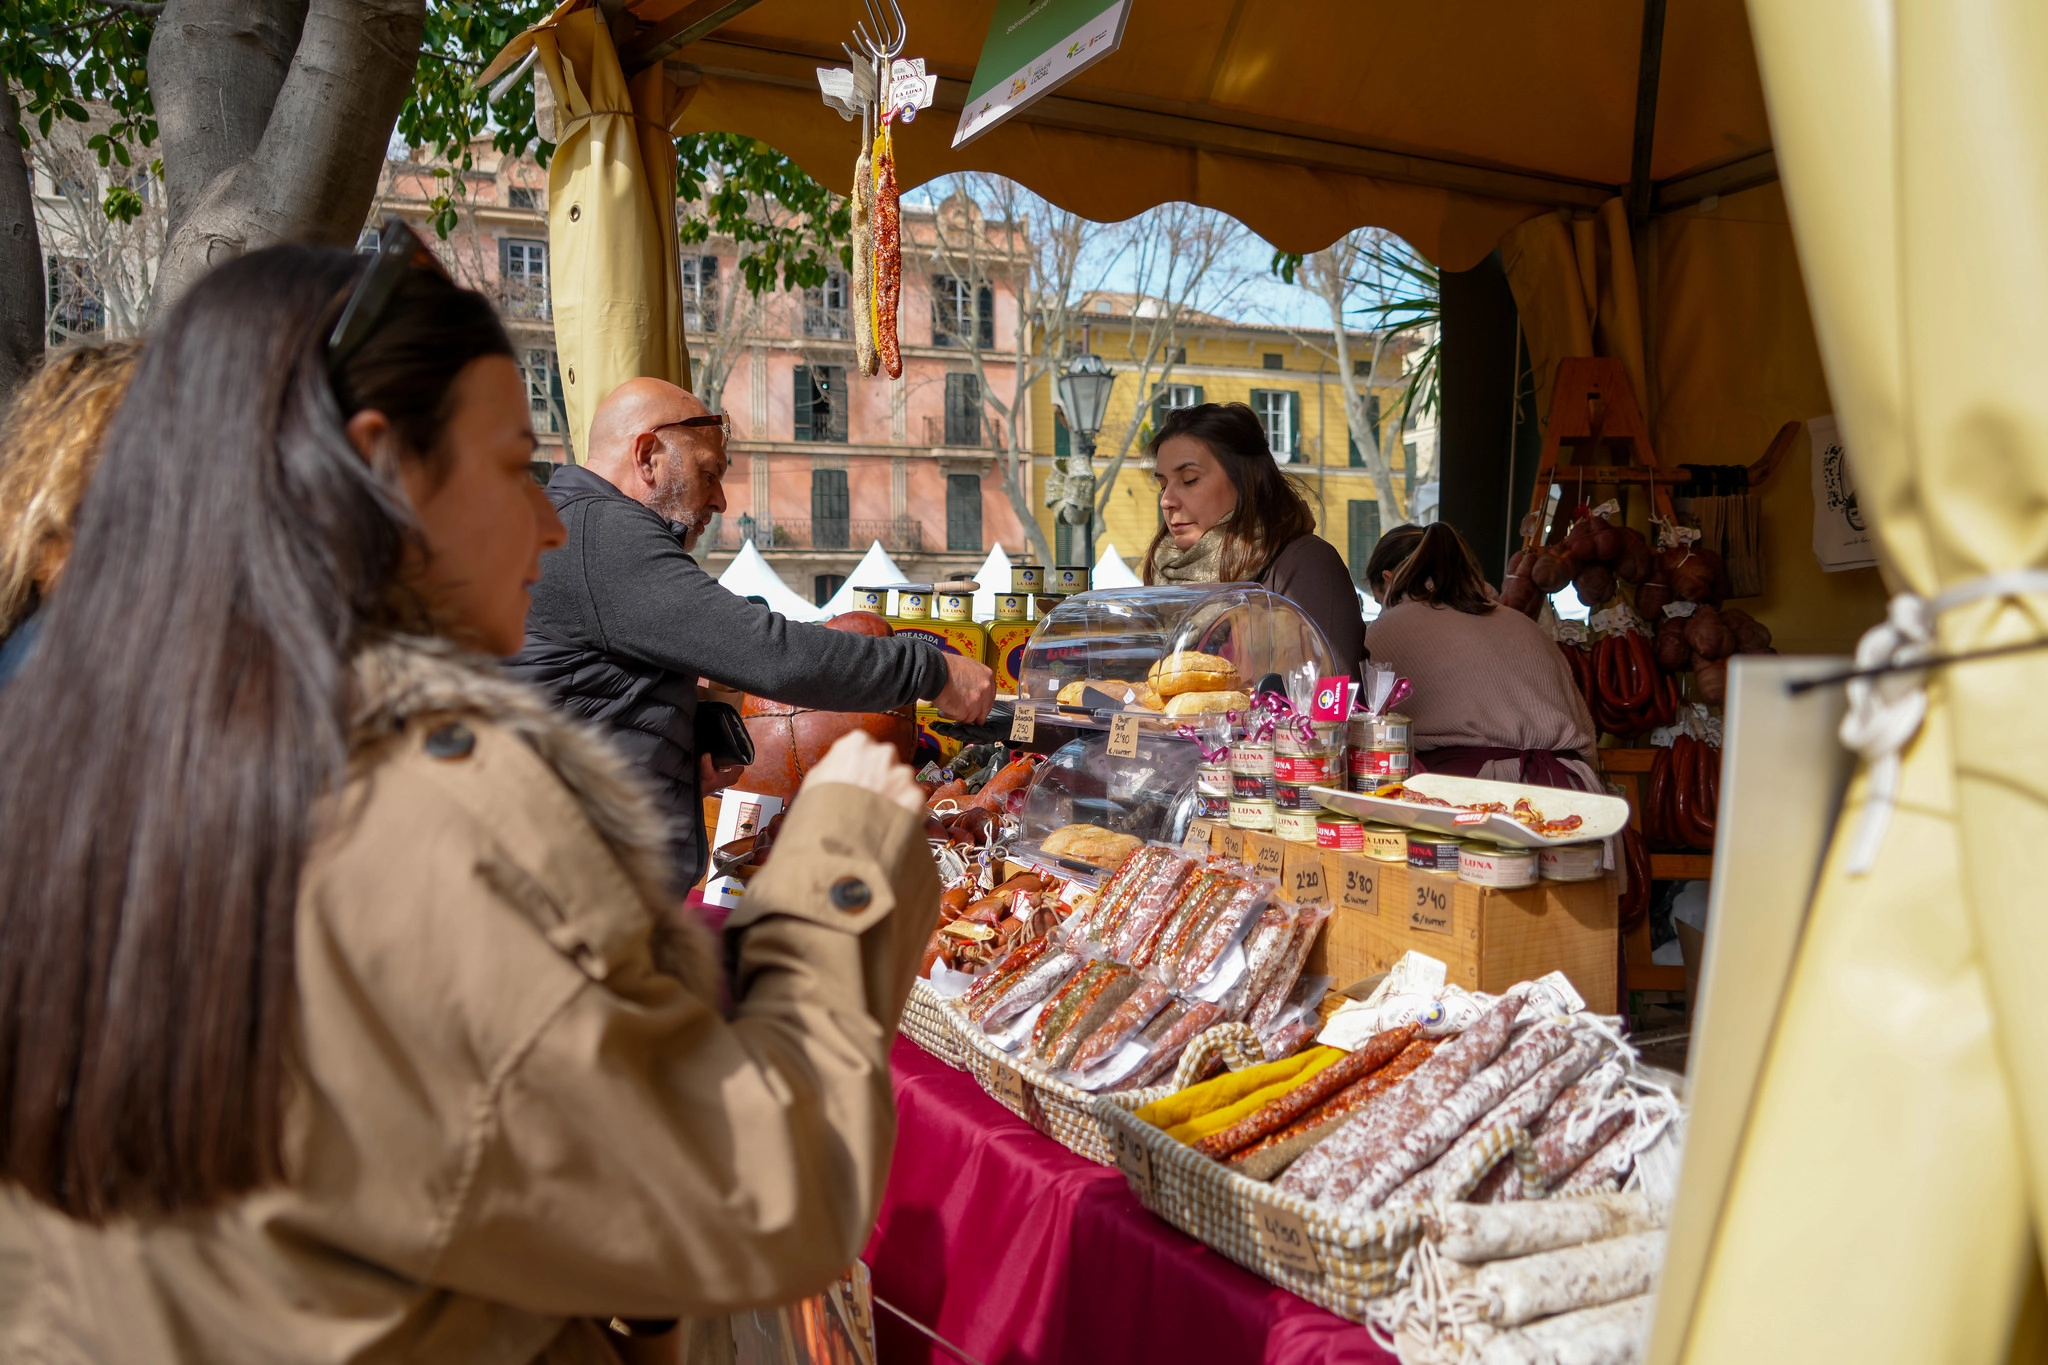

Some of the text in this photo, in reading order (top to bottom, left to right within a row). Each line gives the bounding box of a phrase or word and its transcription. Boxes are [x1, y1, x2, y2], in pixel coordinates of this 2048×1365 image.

[905, 87, 923, 96] LUNA
[1334, 681, 1342, 703] LUNA
[1333, 703, 1340, 715] LA
[1238, 780, 1262, 788] LUNA
[1207, 800, 1219, 808] LA
[1237, 807, 1262, 815] LUNA
[1373, 837, 1399, 845] LUNA
[1258, 846, 1280, 863] 12'50
[1464, 856, 1493, 870] LUNA
[1296, 870, 1319, 890] 2'20
[1346, 870, 1373, 894] 3'80
[1416, 886, 1446, 910] 3'40
